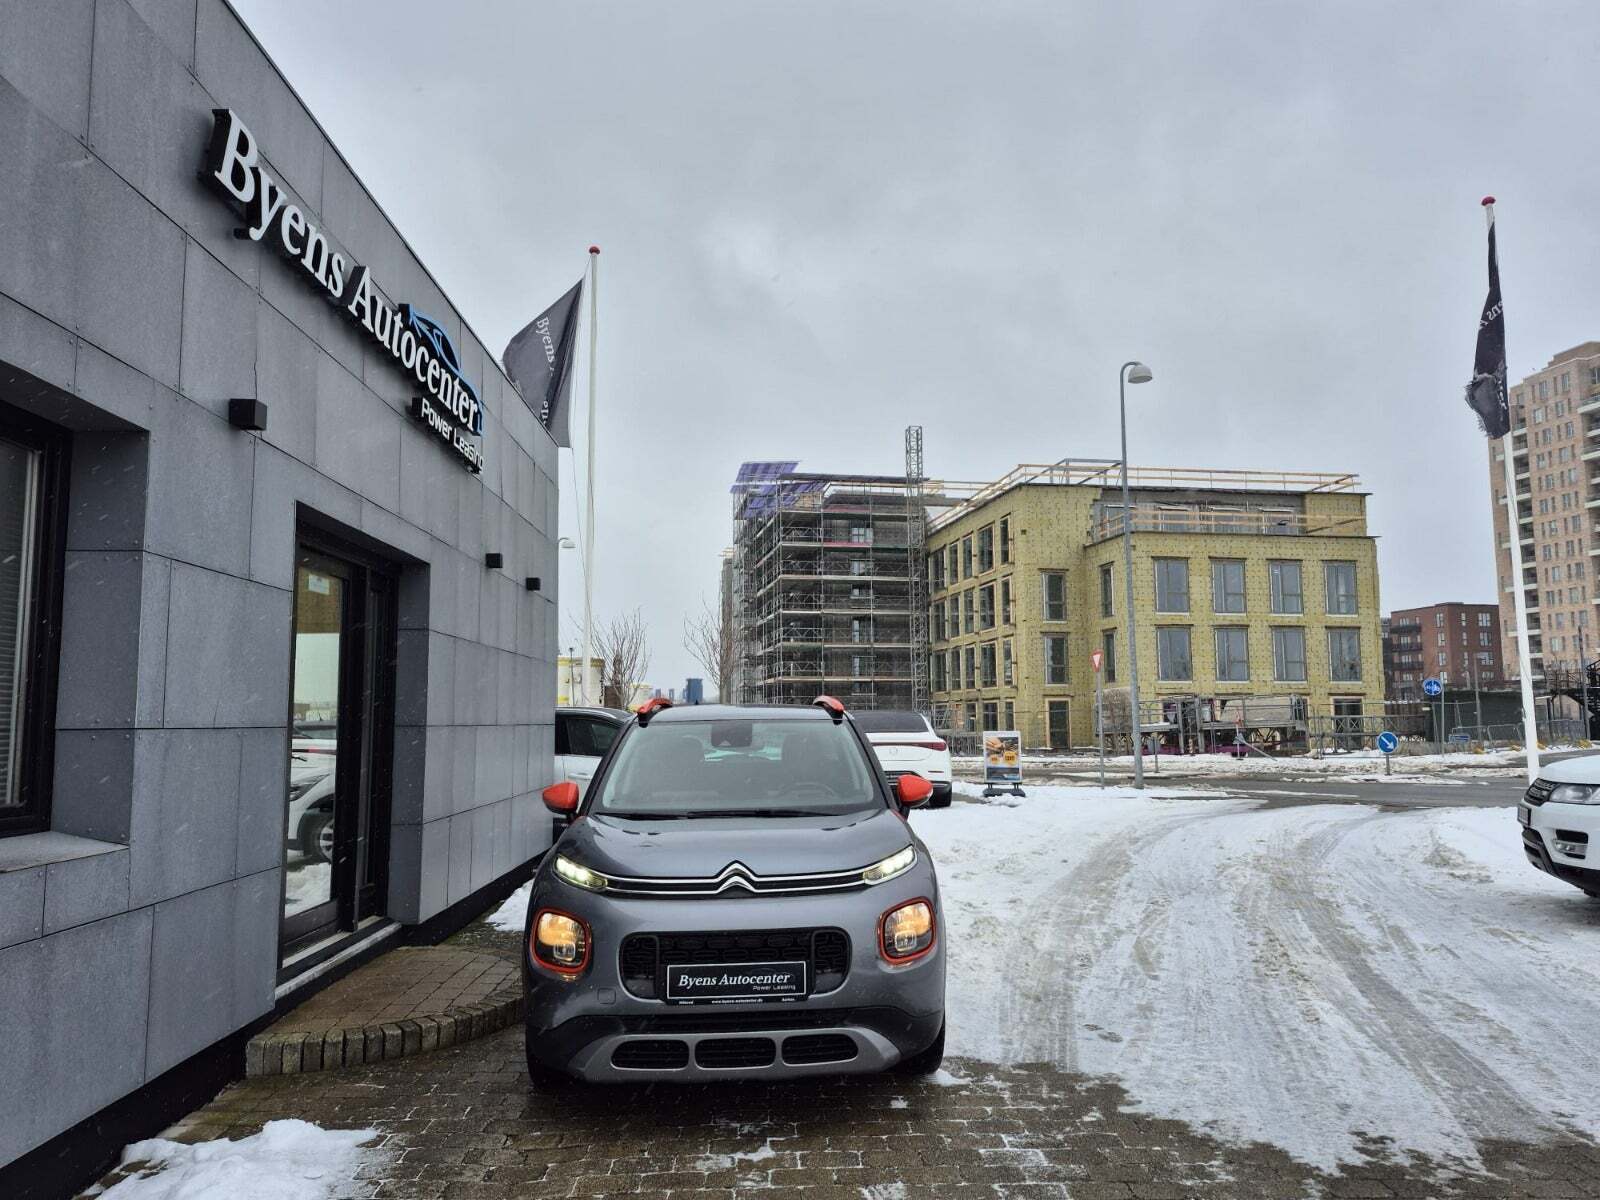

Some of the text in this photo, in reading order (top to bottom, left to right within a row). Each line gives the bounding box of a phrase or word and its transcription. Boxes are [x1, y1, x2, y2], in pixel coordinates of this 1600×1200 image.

[211, 109, 478, 432] Byens Autocenter
[536, 316, 555, 363] Byens
[421, 397, 484, 475] Power Leasing
[679, 973, 791, 989] Byens Autocenter
